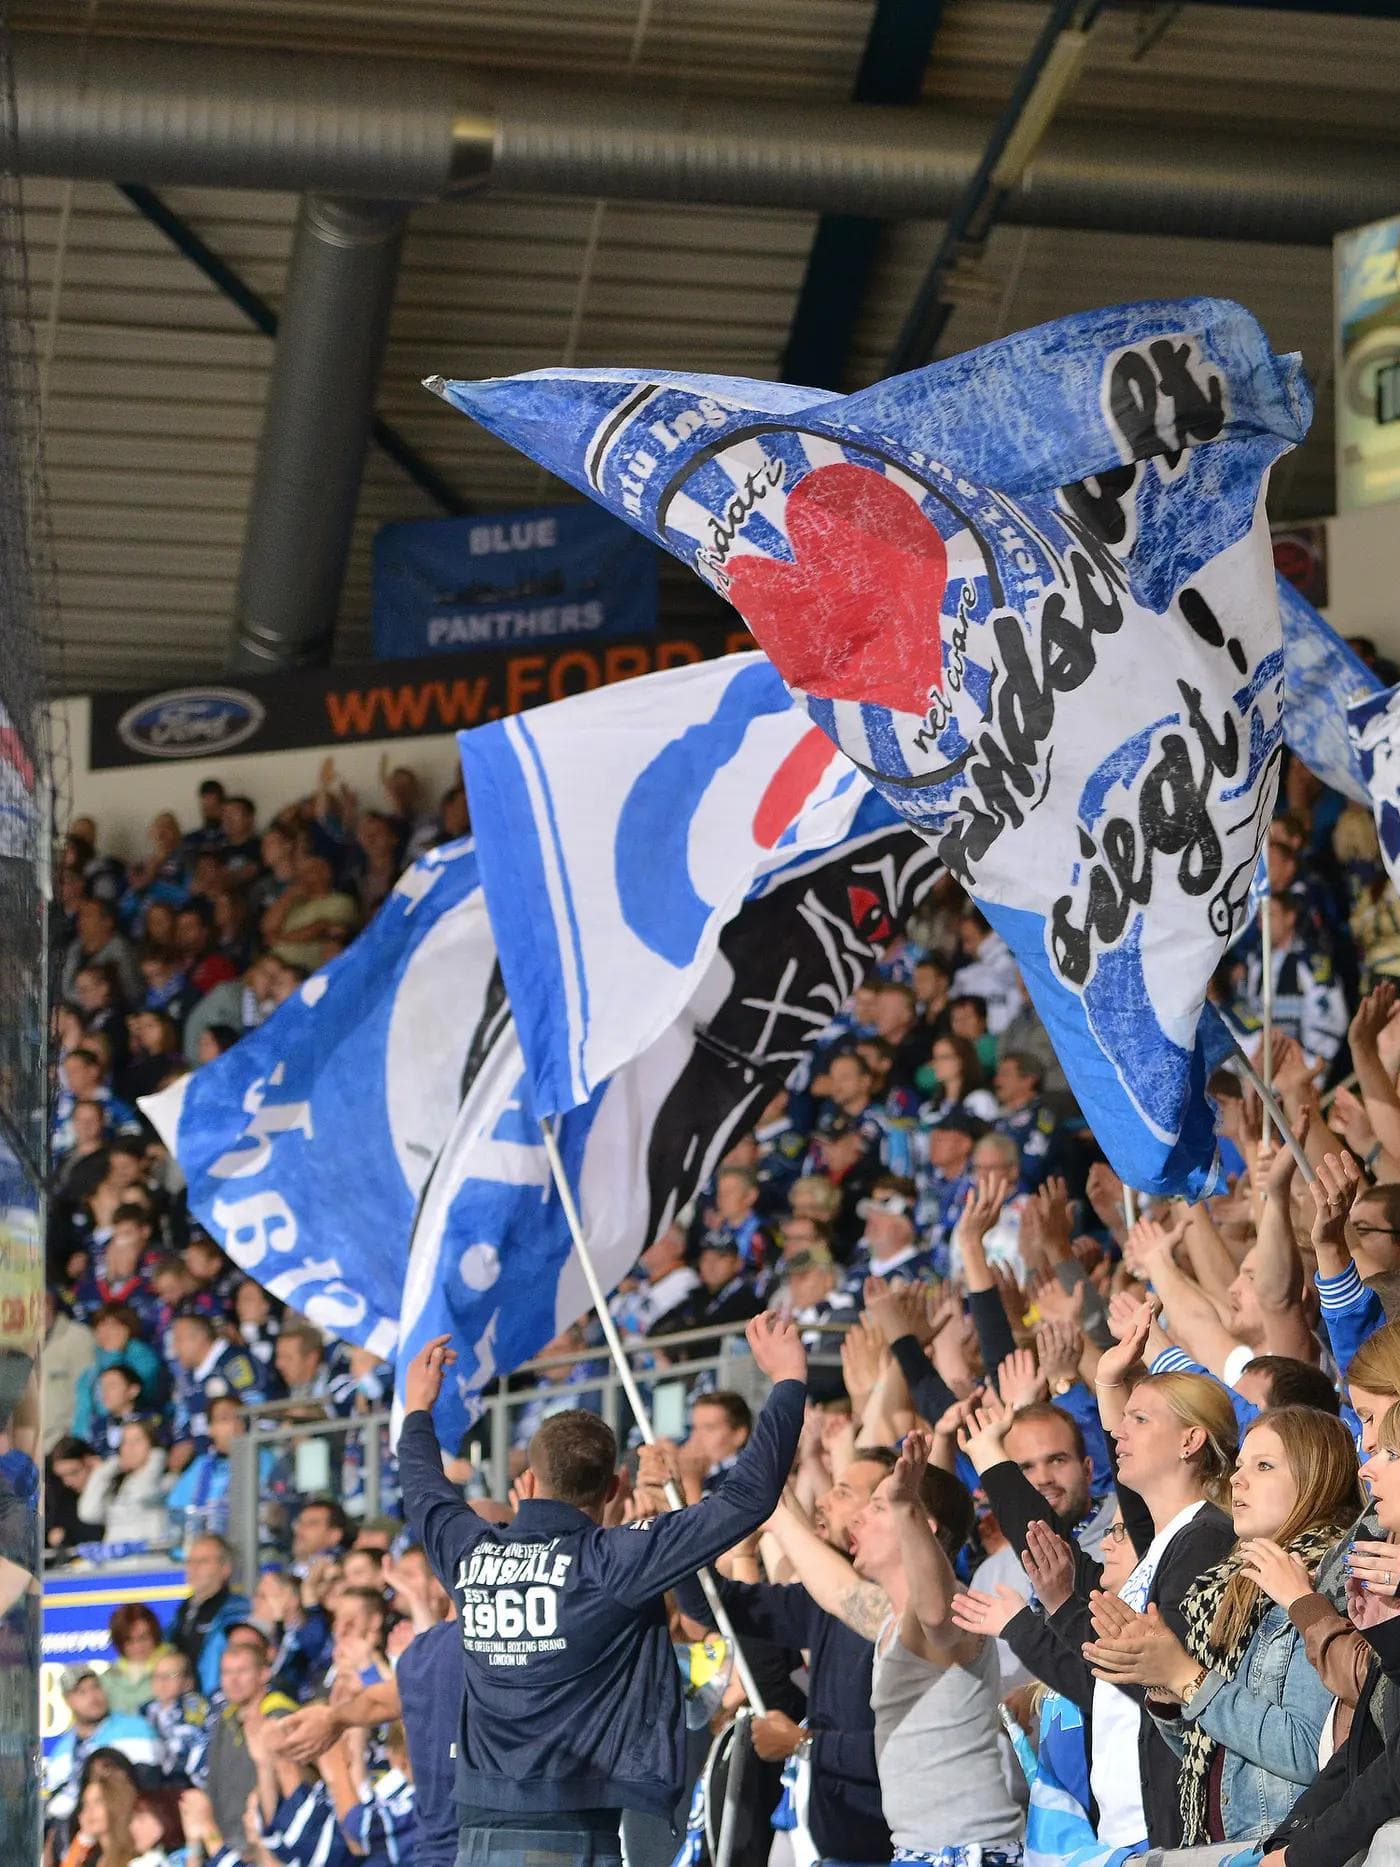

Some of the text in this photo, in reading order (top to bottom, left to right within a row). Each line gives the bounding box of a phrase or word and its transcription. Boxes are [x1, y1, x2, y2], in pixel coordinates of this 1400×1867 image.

[469, 518, 557, 555] BLUE
[427, 600, 604, 646] PANTHERS
[463, 1588, 495, 1604] EST.
[462, 1586, 558, 1638] 1960
[474, 1640, 506, 1653] ORIGINAL
[507, 1640, 537, 1653] BOXING
[538, 1638, 567, 1652] BRAND
[488, 1654, 528, 1666] LONDON UK
